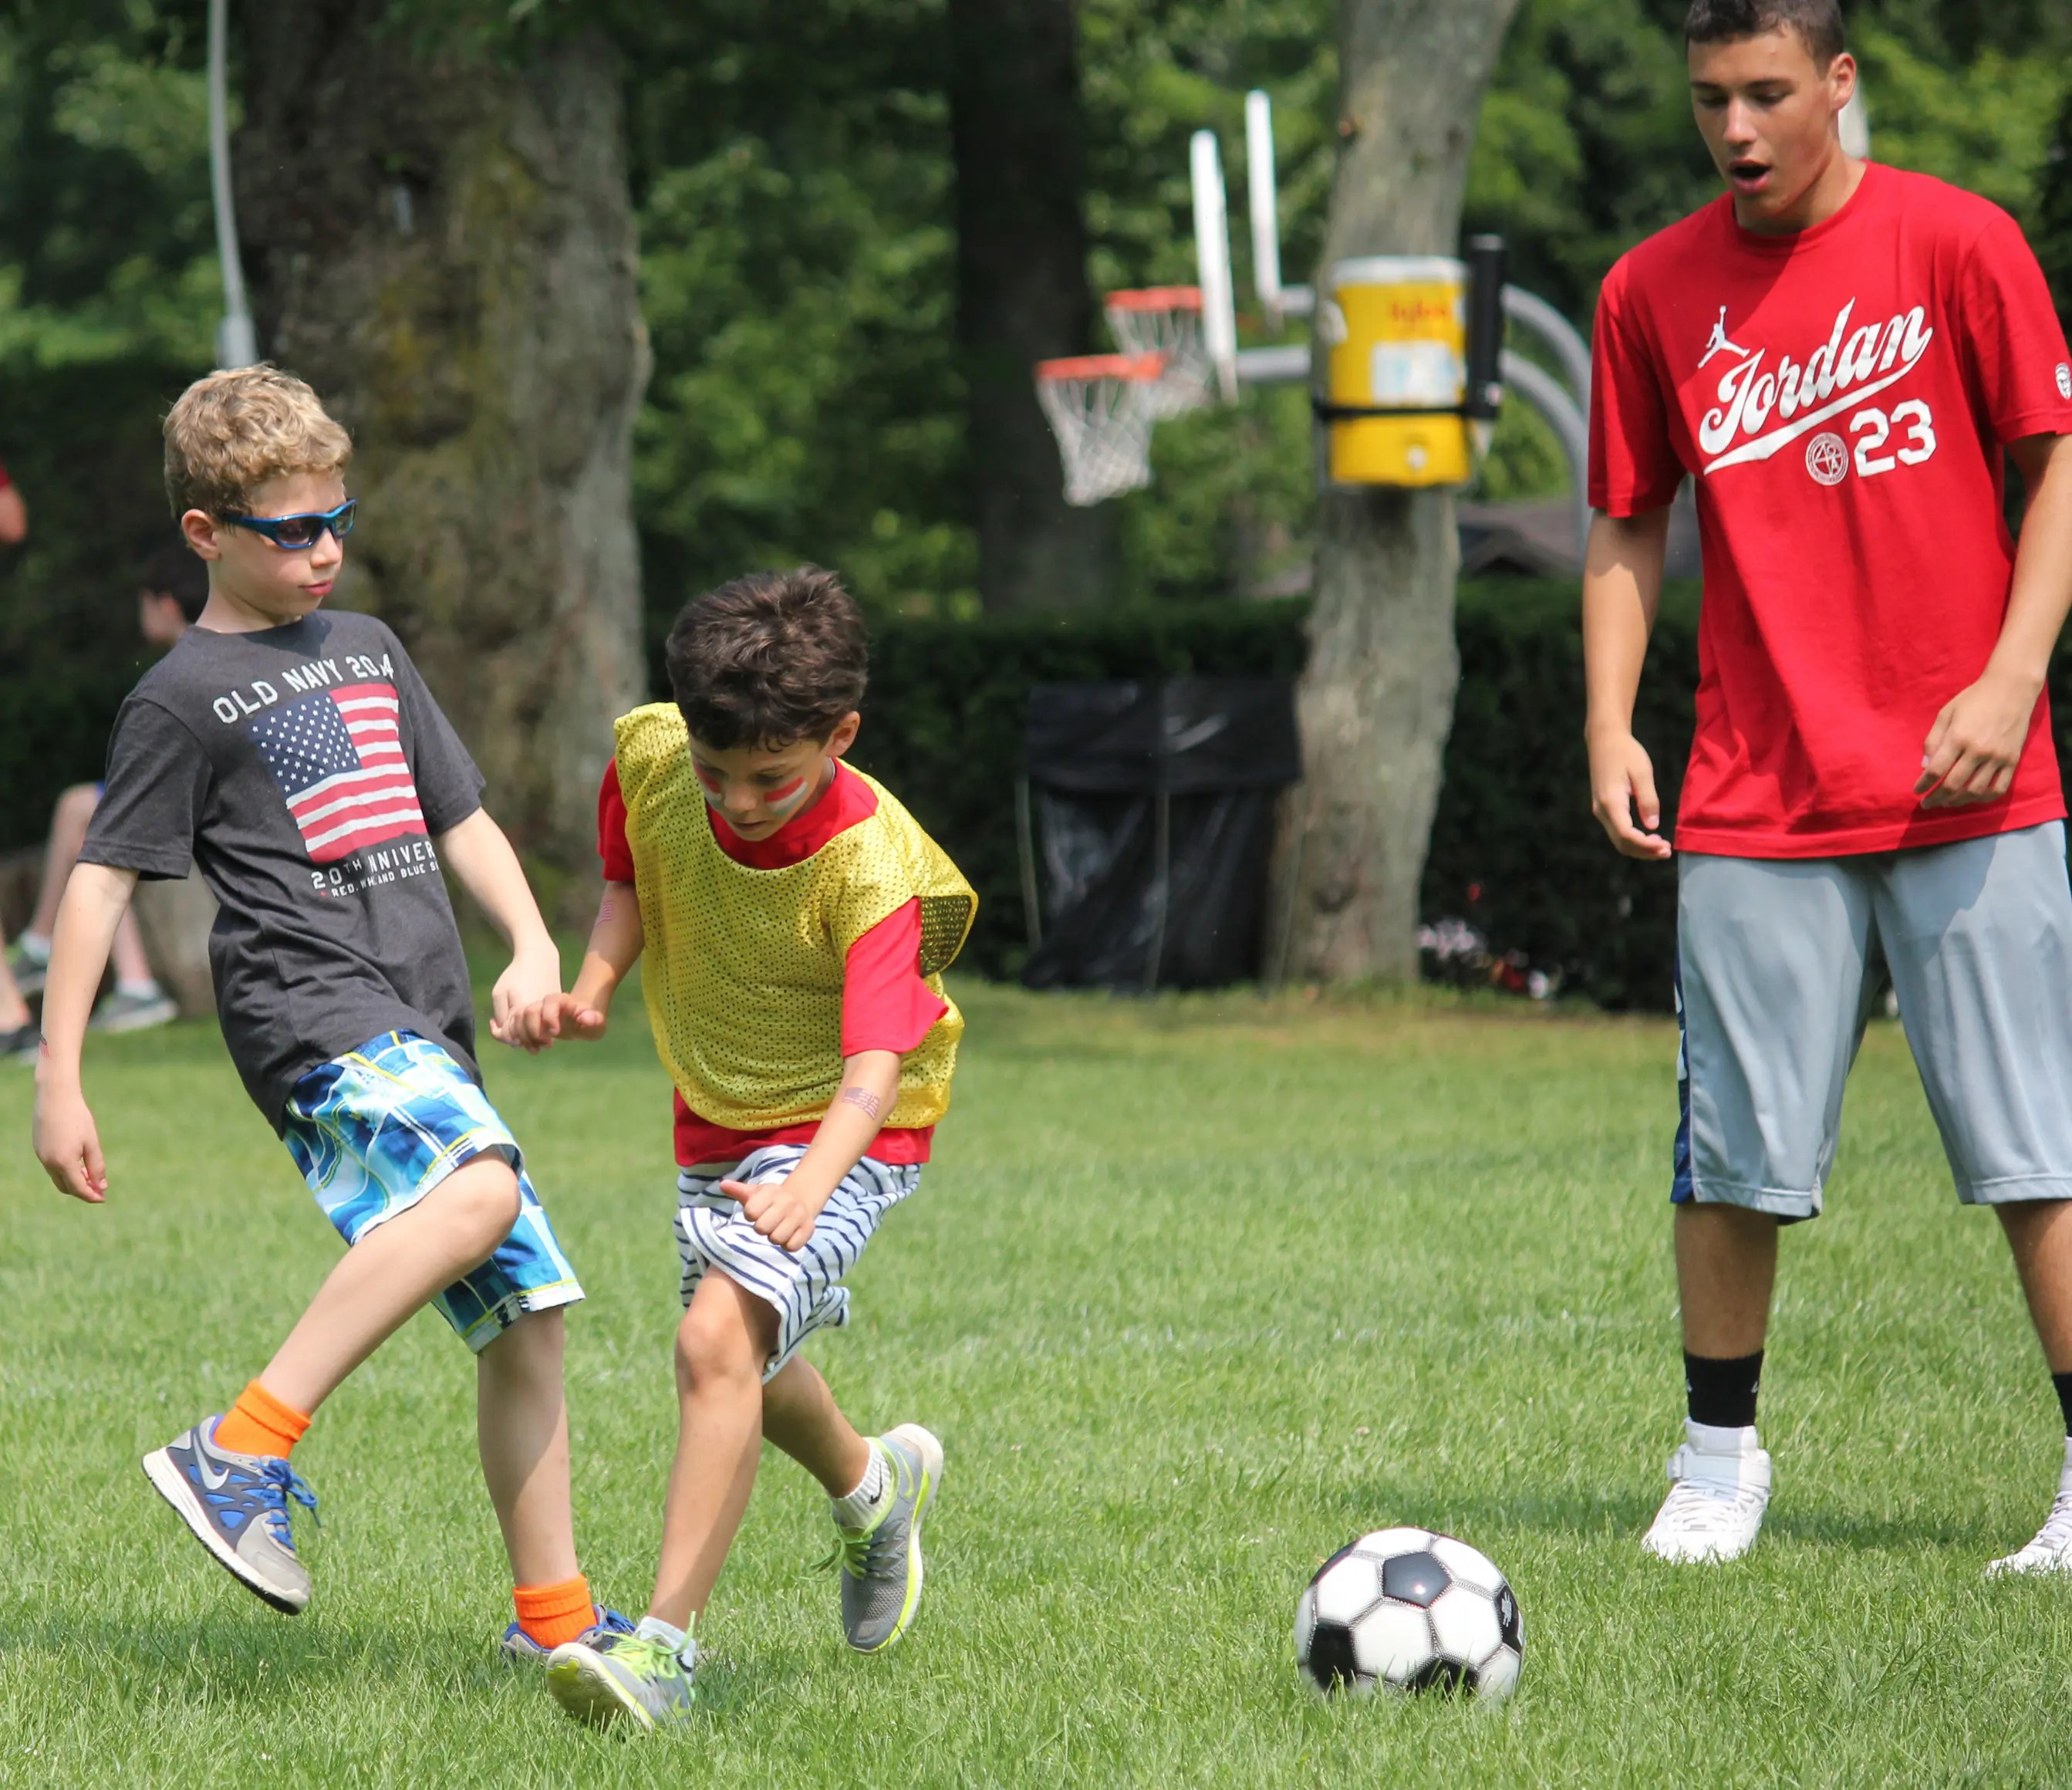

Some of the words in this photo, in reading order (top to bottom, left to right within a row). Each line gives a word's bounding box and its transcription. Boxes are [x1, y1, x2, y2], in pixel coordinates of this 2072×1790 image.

[1699, 297, 1933, 455] Jordan
[1849, 398, 1937, 478] 23
[212, 679, 278, 724] OLD
[282, 658, 343, 693] NAVY
[400, 863, 426, 879] BLUE
